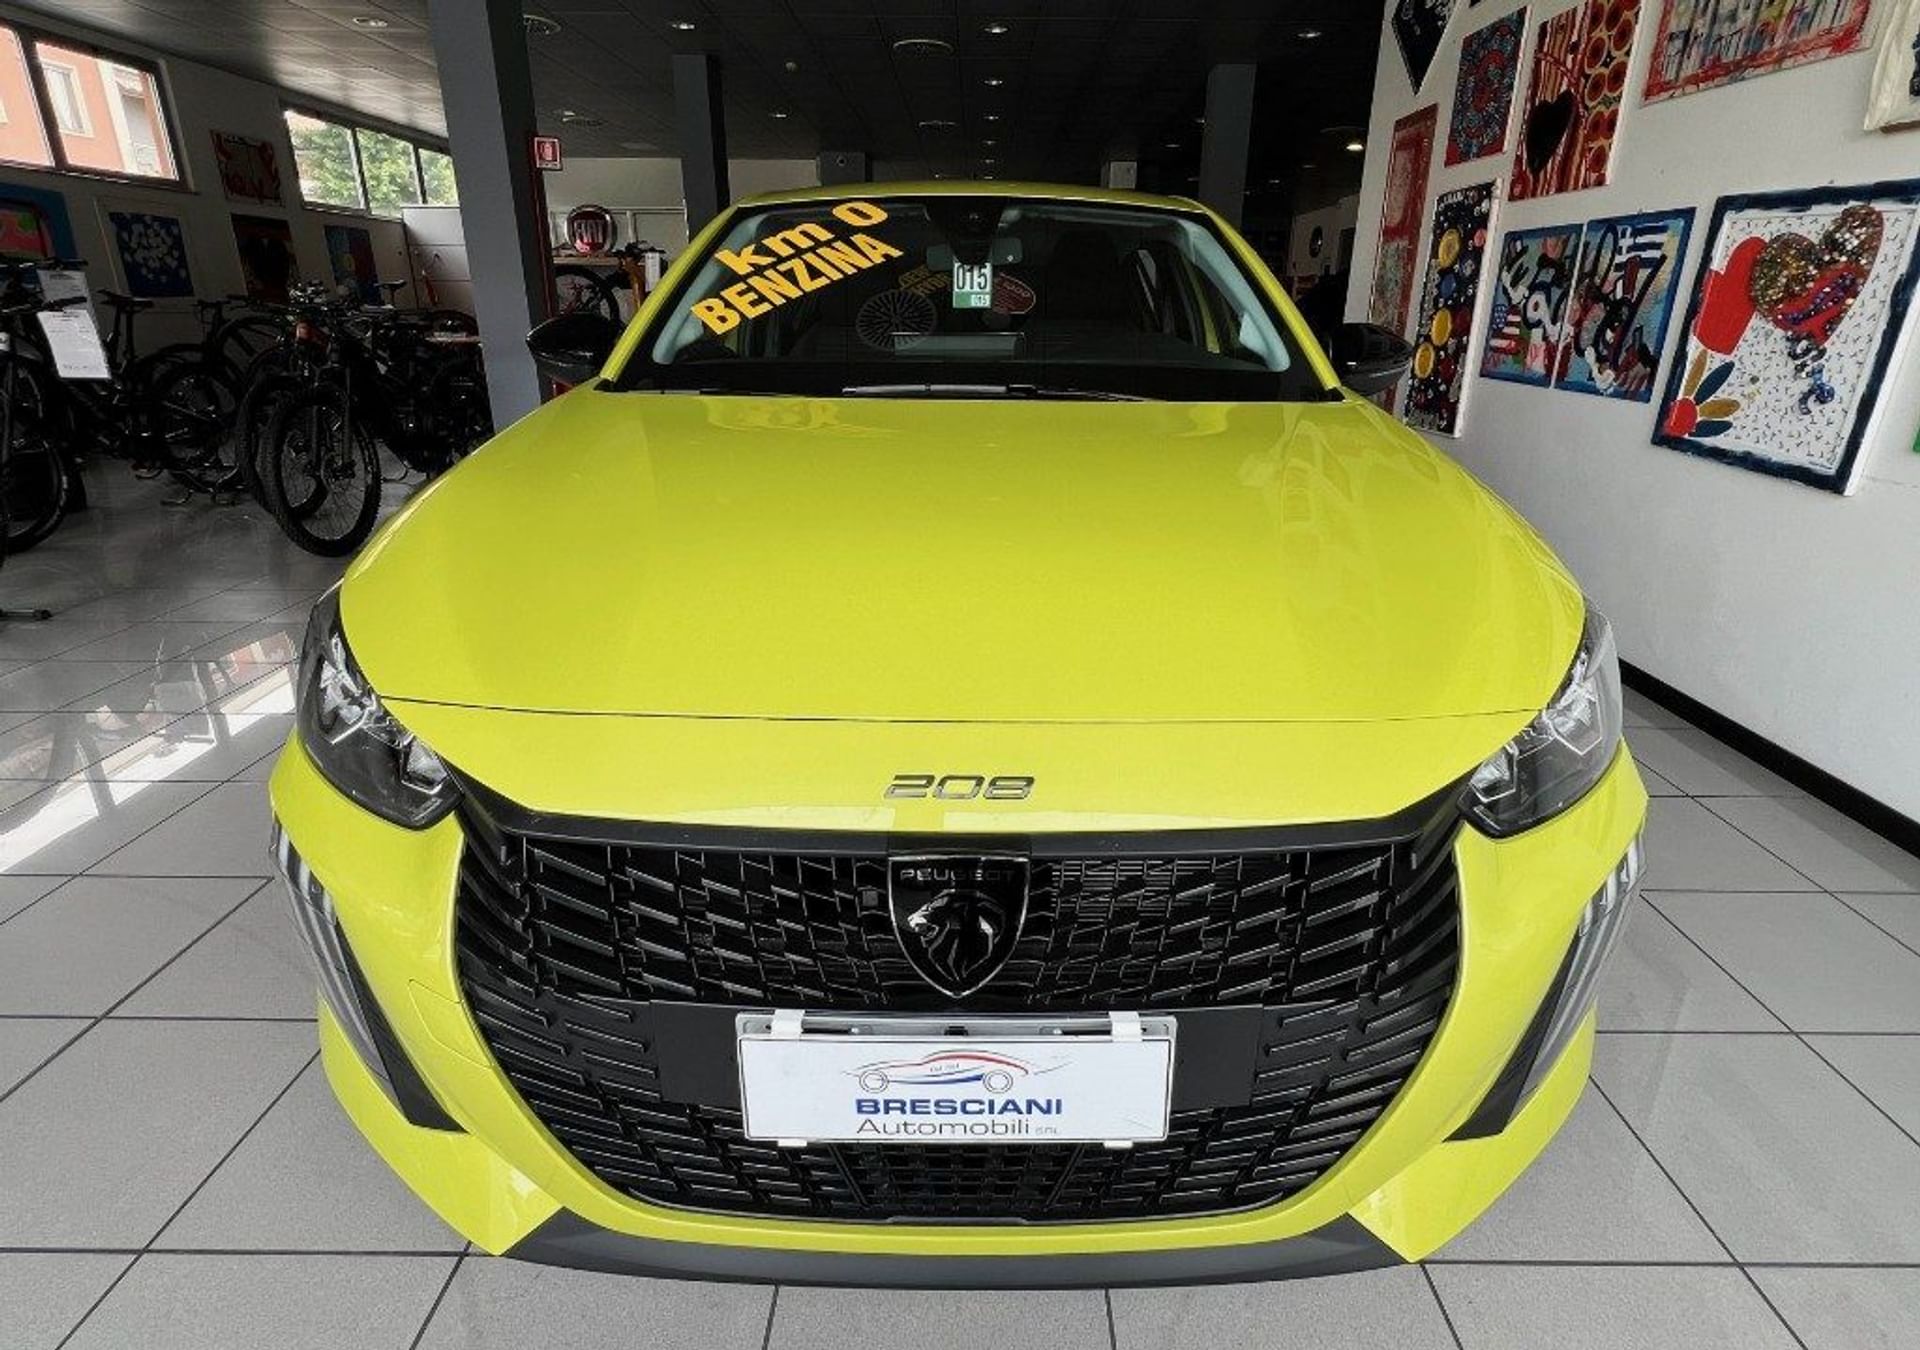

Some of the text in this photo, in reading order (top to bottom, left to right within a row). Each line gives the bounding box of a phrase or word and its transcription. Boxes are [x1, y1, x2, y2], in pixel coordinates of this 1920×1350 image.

[573, 220, 604, 243] FIAT
[715, 223, 835, 275] km
[690, 234, 903, 335] BENZINA
[956, 264, 987, 290] 015
[885, 775, 1034, 799] 208
[901, 868, 1016, 881] PEUGEOT
[856, 1099, 1062, 1115] BRESCIANI
[857, 1118, 1029, 1135] Automobili
